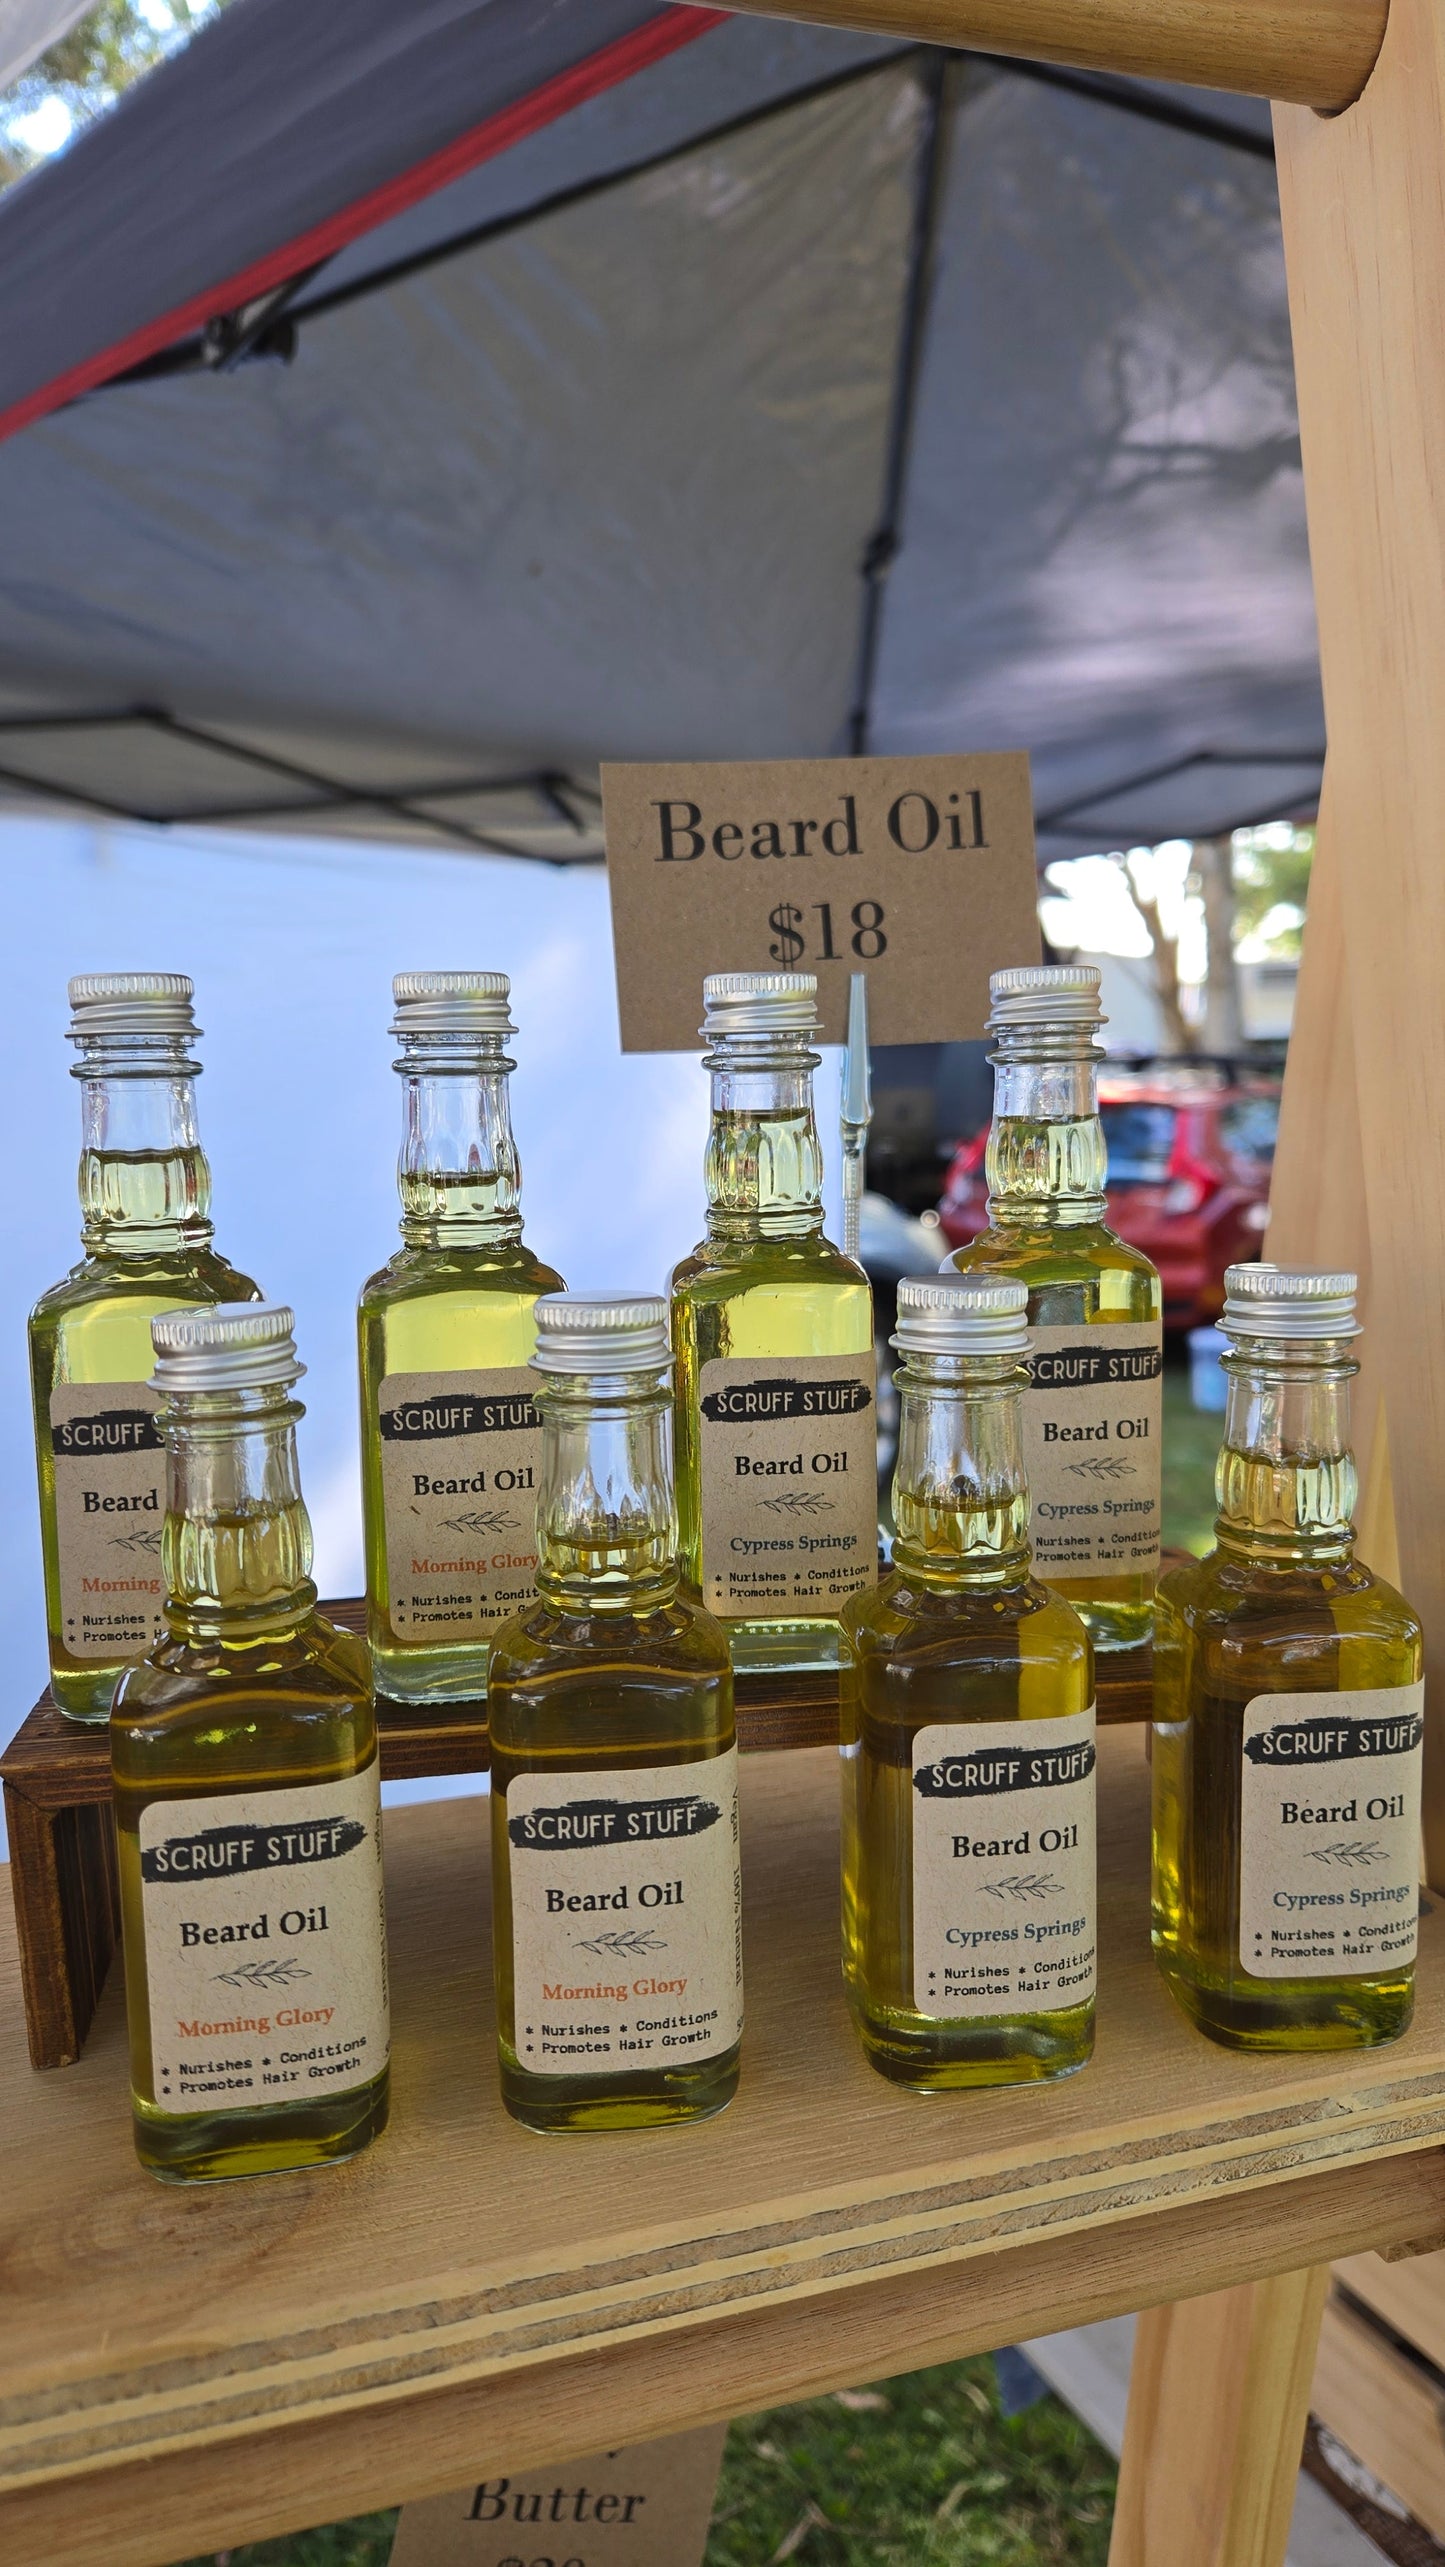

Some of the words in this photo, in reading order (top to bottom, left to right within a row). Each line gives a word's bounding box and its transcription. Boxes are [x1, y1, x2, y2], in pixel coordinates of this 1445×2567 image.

[650, 795, 864, 863] Beard
[887, 789, 991, 854] Oil
[767, 900, 888, 972] $18
[1026, 1358, 1100, 1381] SCRUFF
[1109, 1353, 1158, 1377] STUFF
[717, 1391, 794, 1414] SCRUFF
[803, 1387, 860, 1410] STUFF
[392, 1407, 474, 1431] SCRUFF
[1042, 1420, 1108, 1442] Beard
[1116, 1417, 1149, 1440] Oil
[61, 1422, 145, 1447] SCRUFF
[735, 1454, 803, 1476] Beard
[811, 1451, 849, 1474] Oil
[412, 1471, 486, 1496] Beard
[494, 1467, 535, 1492] Oil
[82, 1489, 160, 1513] Beard
[1037, 1501, 1099, 1519] Cypress
[1103, 1498, 1155, 1517] Springs
[730, 1537, 794, 1555] Cypress
[799, 1535, 858, 1553] Springs
[1036, 1536, 1091, 1547] Nurishes
[411, 1559, 487, 1575] Morning
[491, 1554, 539, 1570] Glory
[1036, 1551, 1091, 1562] Promotes
[1098, 1549, 1124, 1560] Hair
[82, 1576, 161, 1594] Morning
[729, 1572, 786, 1582] Nurishes
[808, 1564, 870, 1580] Conditions
[412, 1594, 472, 1607] Nurishes
[729, 1587, 786, 1598] Promotes
[793, 1585, 823, 1597] Hair
[829, 1580, 866, 1594] Growth
[83, 1615, 146, 1626] Nurishes
[413, 1609, 473, 1623] Promotes
[480, 1606, 511, 1618] Hair
[83, 1631, 146, 1642] Promotes
[1262, 1730, 1349, 1755] SCRUFF
[1358, 1722, 1417, 1752] STUFF
[931, 1761, 1020, 1788] SCRUFF
[1030, 1750, 1090, 1781] STUFF
[523, 1814, 616, 1840] SCRUFF
[628, 1805, 698, 1836] STUFF
[1280, 1800, 1358, 1825] Beard
[1366, 1795, 1405, 1820] Oil
[155, 1839, 254, 1873] SCRUFF
[266, 1826, 346, 1862] STUFF
[951, 1831, 1031, 1858] Beard
[1039, 1824, 1079, 1852] Oil
[545, 1886, 629, 1912] Beard
[638, 1880, 685, 1909] Oil
[1273, 1891, 1345, 1912] Cypress
[1350, 1884, 1411, 1907] Springs
[179, 1915, 270, 1948] Beard
[280, 1906, 330, 1937] Oil
[945, 1927, 1019, 1948] Cypress
[1024, 1916, 1086, 1942] Springs
[1271, 1929, 1335, 1941] Nurishes
[1358, 1914, 1418, 1938] Condition
[1271, 1946, 1335, 1958] Promotes
[1343, 1942, 1375, 1955] Hair
[944, 1966, 1010, 1979] Nurishes
[944, 1983, 1010, 1996] Promotes
[1018, 1979, 1051, 1992] Hair
[1057, 1965, 1093, 1988] Growth
[541, 1982, 628, 2001] Morning
[632, 1978, 688, 1998] Glory
[177, 2014, 271, 2039] Morning
[275, 2007, 335, 2029] Glory
[542, 2023, 611, 2036] Nurishes
[636, 2009, 718, 2031] Conditions
[542, 2041, 611, 2054] Promotes
[619, 2038, 654, 2051] Hair
[662, 2029, 711, 2047] Growth
[179, 2058, 253, 2076] Nurishes
[280, 2036, 367, 2065] Conditions
[180, 2077, 253, 2094] Promotes
[263, 2071, 300, 2085] Hair
[308, 2056, 361, 2078] Growth
[462, 2477, 646, 2524] Butter
